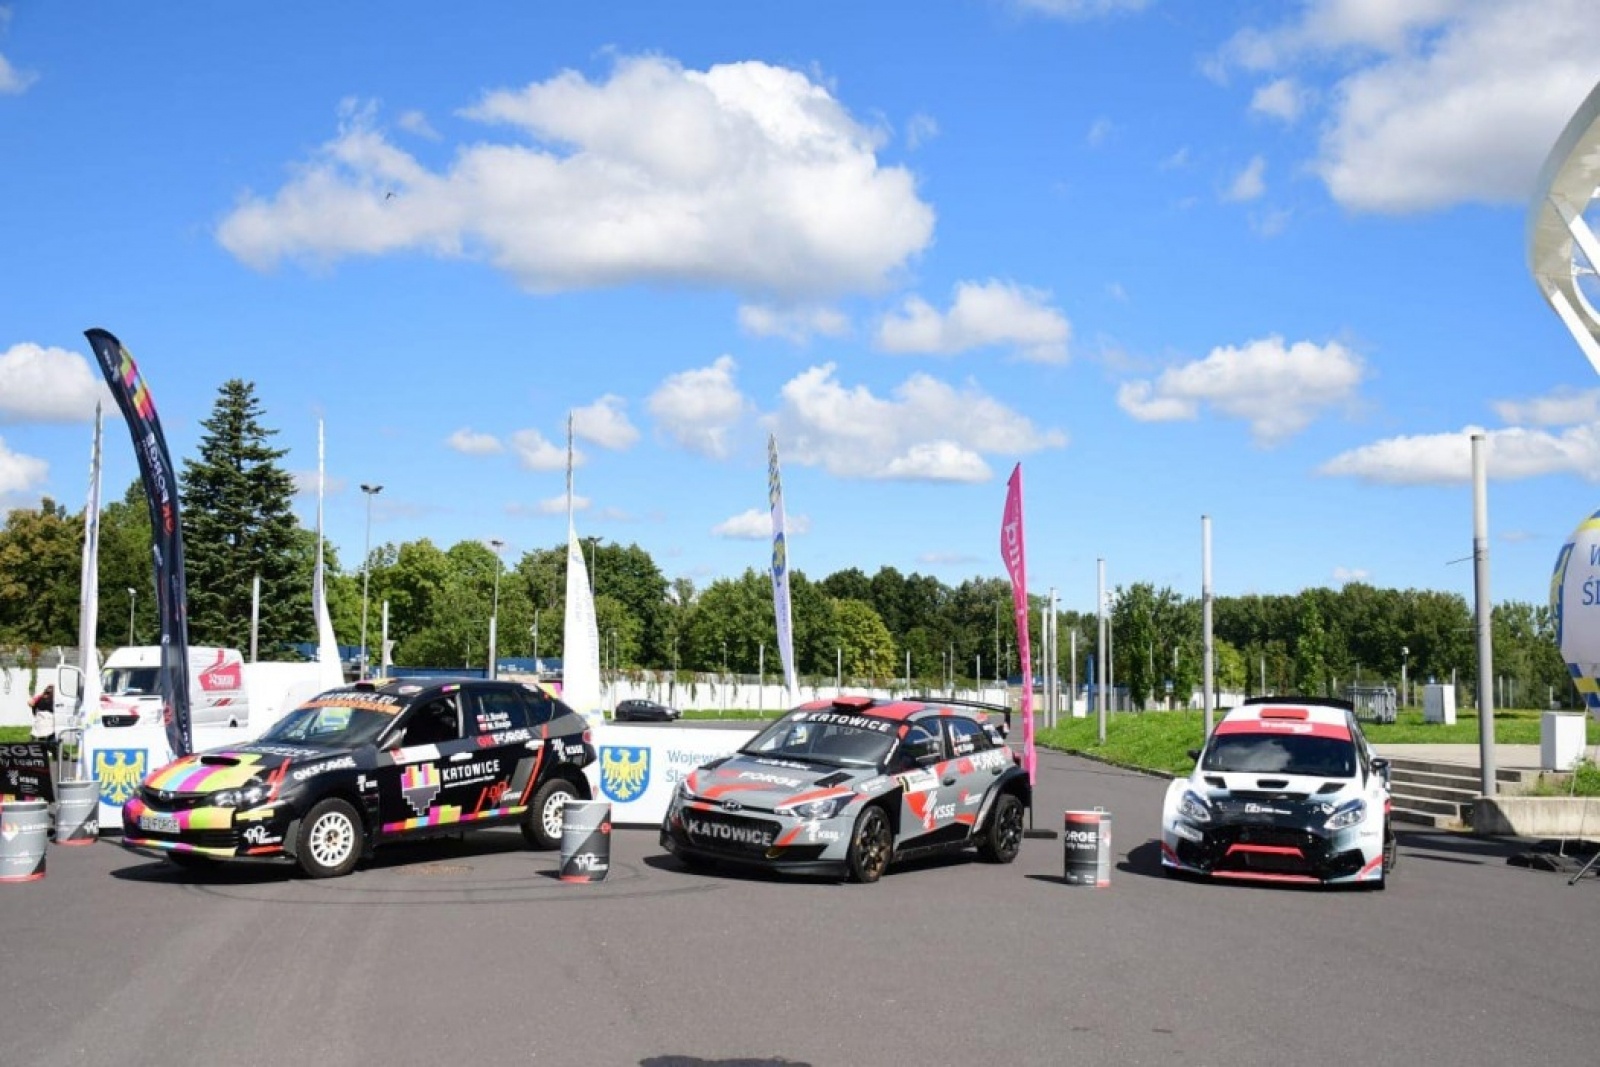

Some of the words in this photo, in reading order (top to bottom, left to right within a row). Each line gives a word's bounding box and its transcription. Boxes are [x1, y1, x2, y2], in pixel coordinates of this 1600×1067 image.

[807, 713, 891, 733] KATOWICE
[442, 760, 500, 782] KATOWICE
[934, 803, 956, 819] KSSE
[688, 820, 773, 847] KATOWICE
